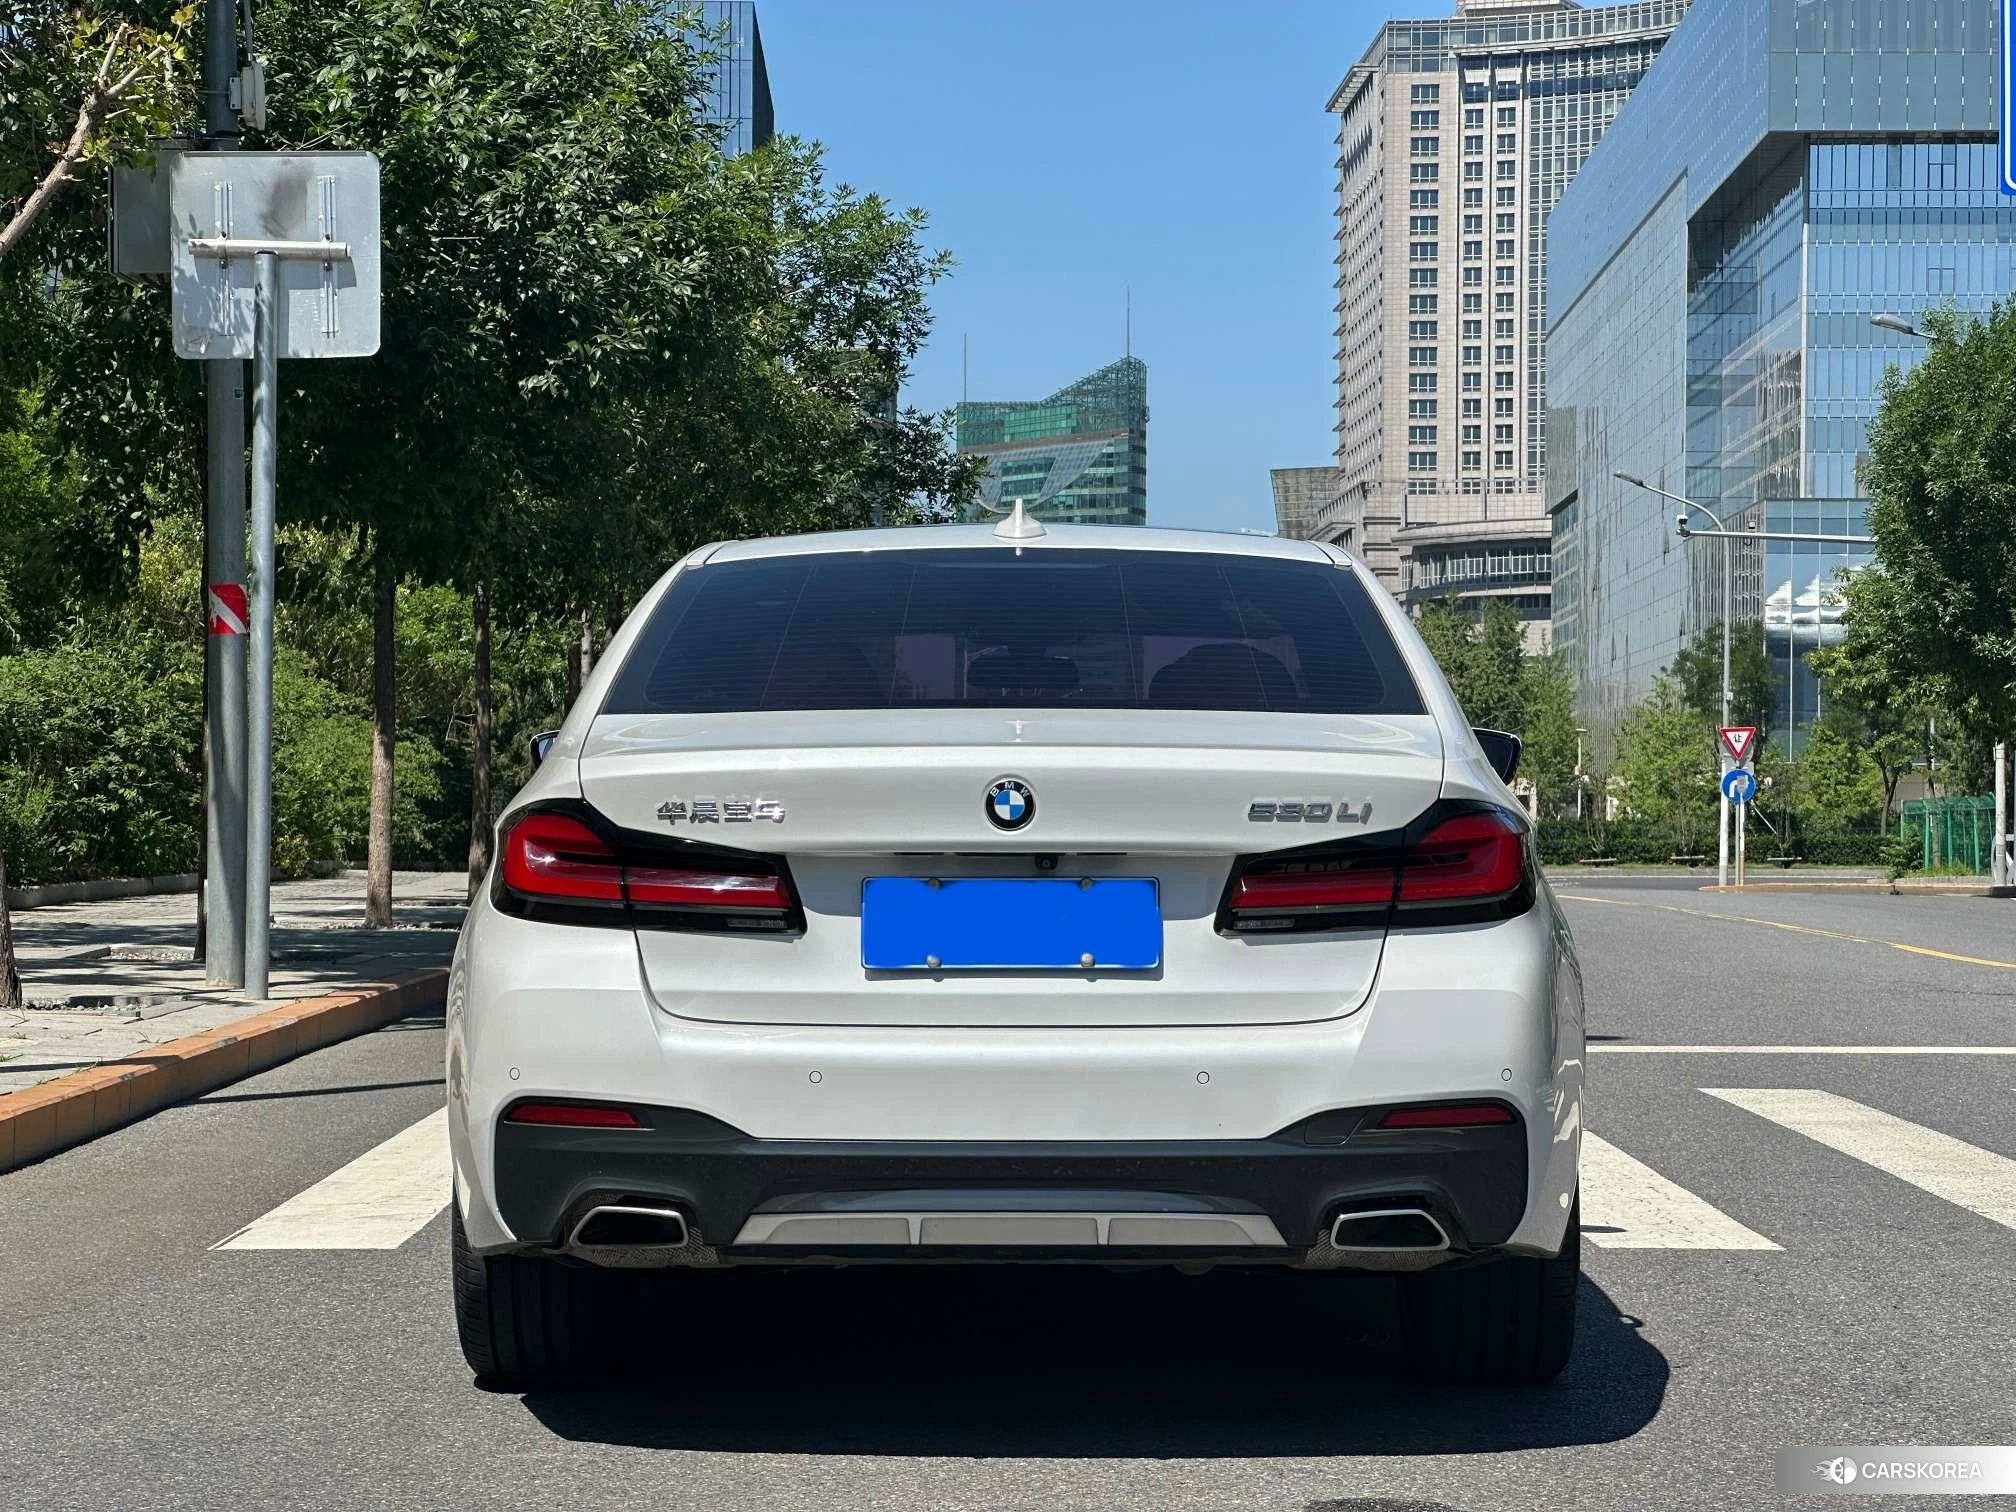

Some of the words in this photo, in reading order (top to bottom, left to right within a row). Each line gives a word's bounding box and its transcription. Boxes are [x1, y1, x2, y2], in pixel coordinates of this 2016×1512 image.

[989, 780, 1031, 798] BMW
[656, 799, 786, 825] 华晨宝马
